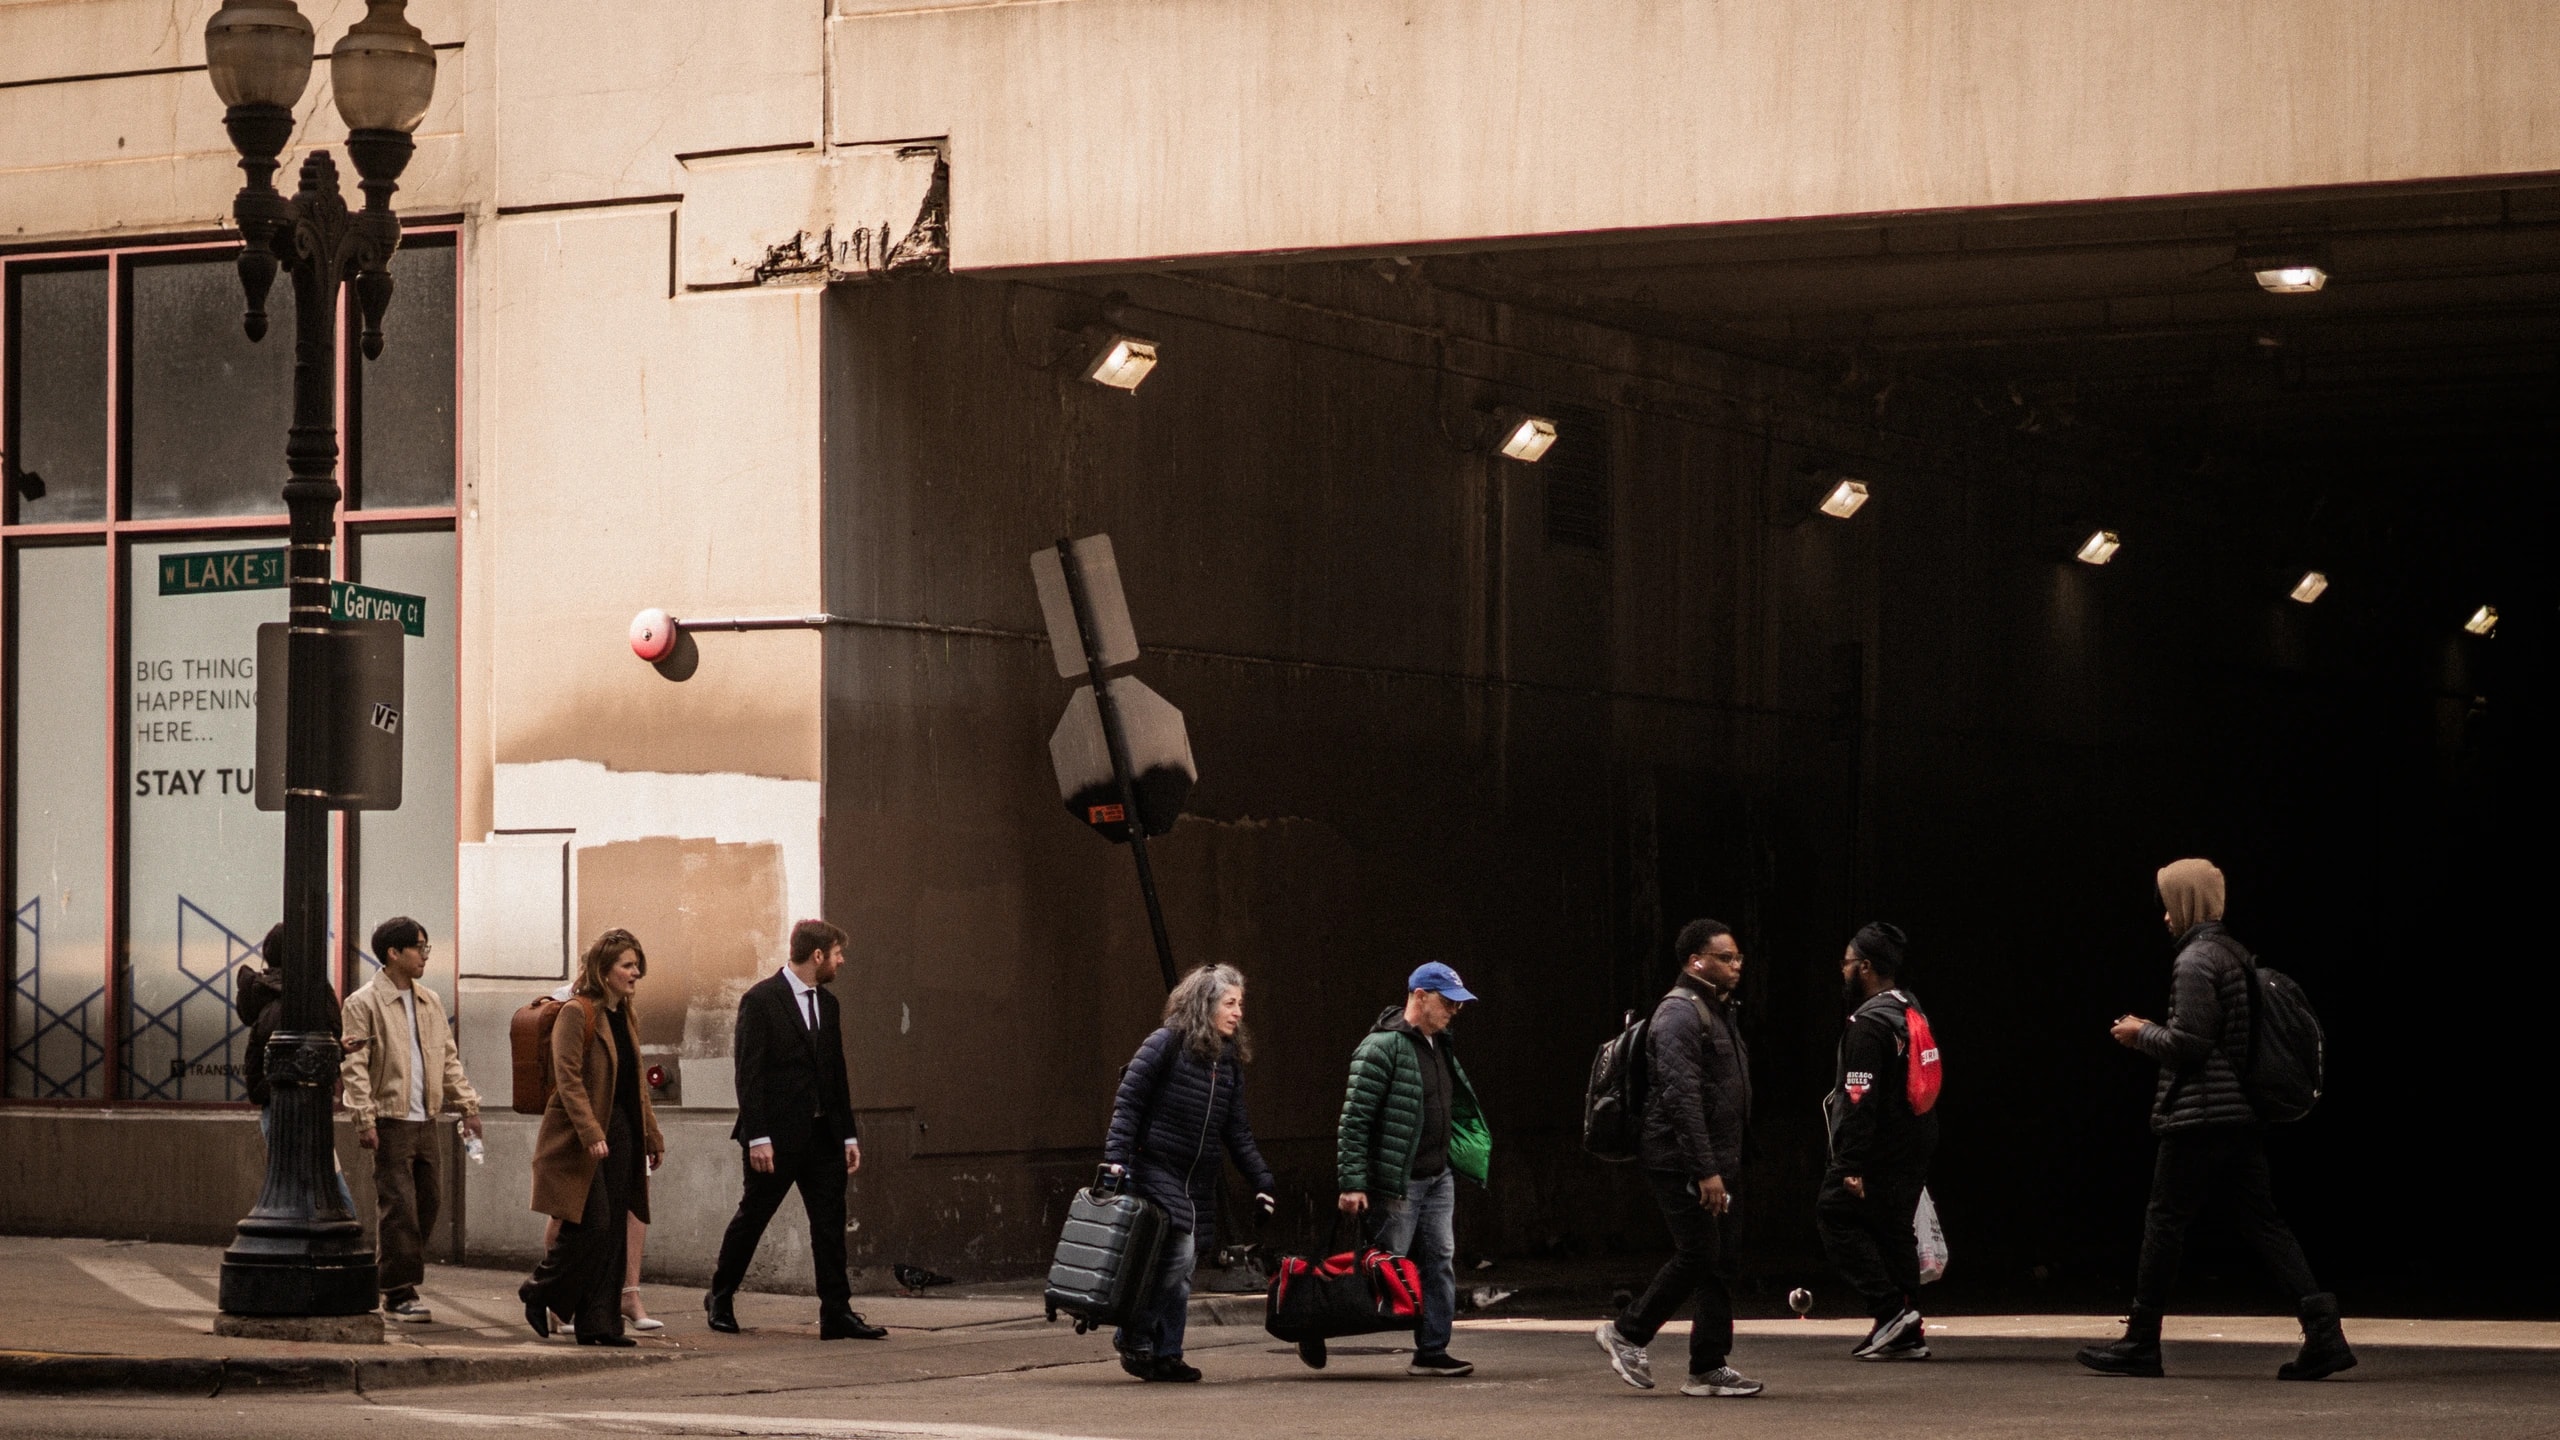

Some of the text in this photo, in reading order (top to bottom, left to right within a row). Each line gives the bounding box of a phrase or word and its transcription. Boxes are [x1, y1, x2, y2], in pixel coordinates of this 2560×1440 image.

[165, 554, 278, 588] W LAKE ST
[331, 585, 418, 623] N Garvey Ct
[137, 657, 254, 682] BIG THING
[372, 702, 398, 730] VF
[137, 721, 213, 743] HERE...
[135, 768, 254, 797] STAY TU
[189, 1064, 249, 1075] TRANSWE
